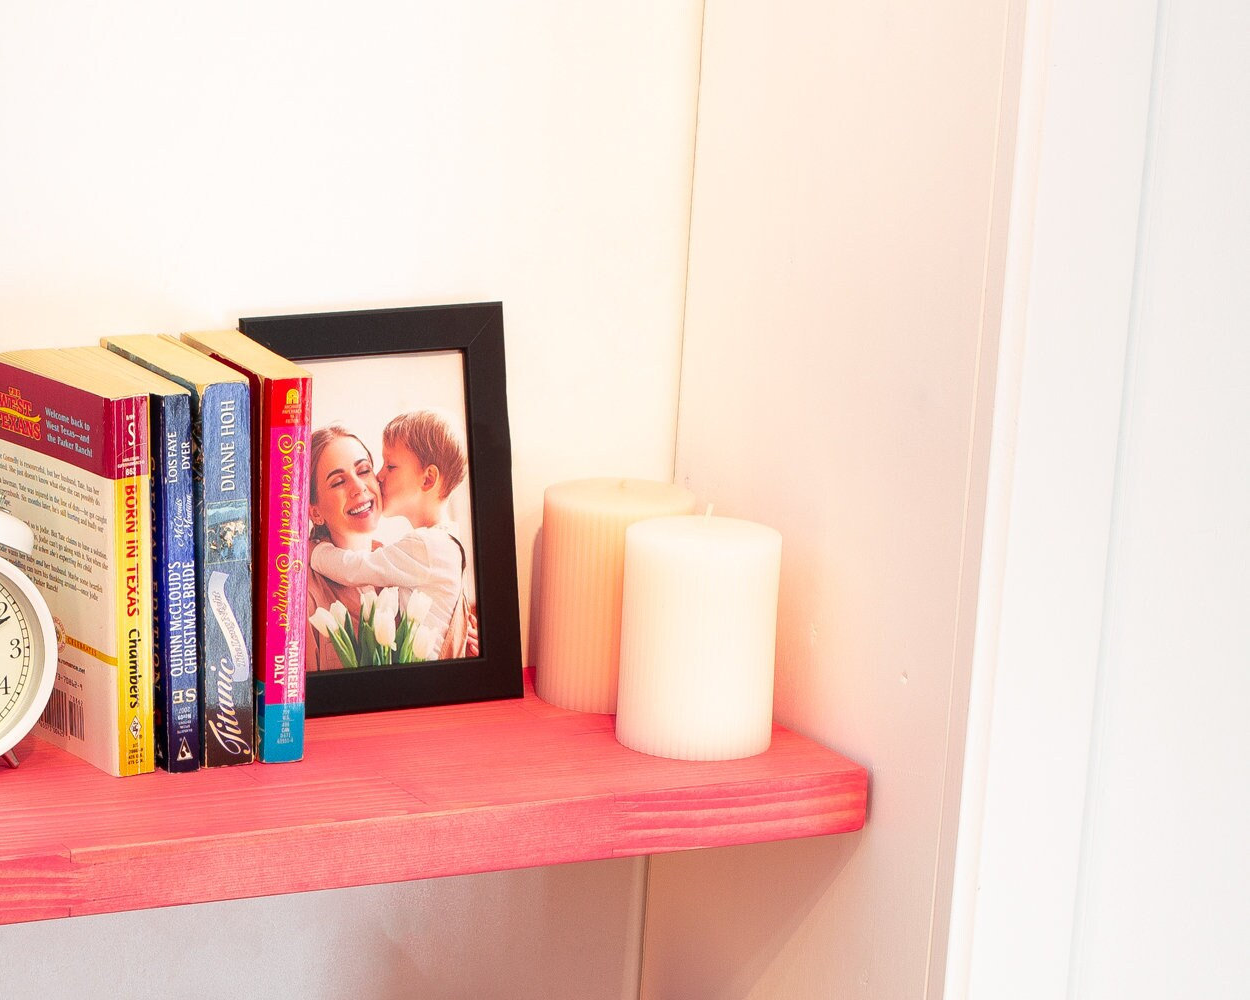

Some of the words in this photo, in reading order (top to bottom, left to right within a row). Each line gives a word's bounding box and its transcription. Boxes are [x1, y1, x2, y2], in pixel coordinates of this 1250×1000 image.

[45, 407, 69, 424] Welcome
[71, 416, 83, 429] back
[84, 421, 90, 431] to
[46, 419, 59, 432] West
[221, 400, 235, 437] HOH
[47, 434, 56, 444] the
[57, 437, 74, 450] Parker
[75, 443, 92, 457] Ranch!
[168, 431, 177, 459] FAYE
[181, 442, 191, 470] DYER
[168, 460, 178, 484] LOIS
[221, 442, 236, 492] DIANE
[124, 484, 138, 536] BORN
[277, 434, 306, 546] Seventeenth
[124, 539, 139, 560] IN
[126, 563, 140, 618] TEXAS
[168, 561, 182, 632] McCLOUD'S
[182, 560, 195, 598] BRIDE
[272, 553, 303, 632] Summer
[9, 638, 21, 659] 3
[170, 634, 183, 677] QUINN
[183, 600, 198, 674] CHRISTMAS
[128, 628, 142, 709] Chambers
[274, 655, 286, 687] DALY
[287, 640, 298, 699] MAUREEN
[208, 657, 250, 755] Titanic
